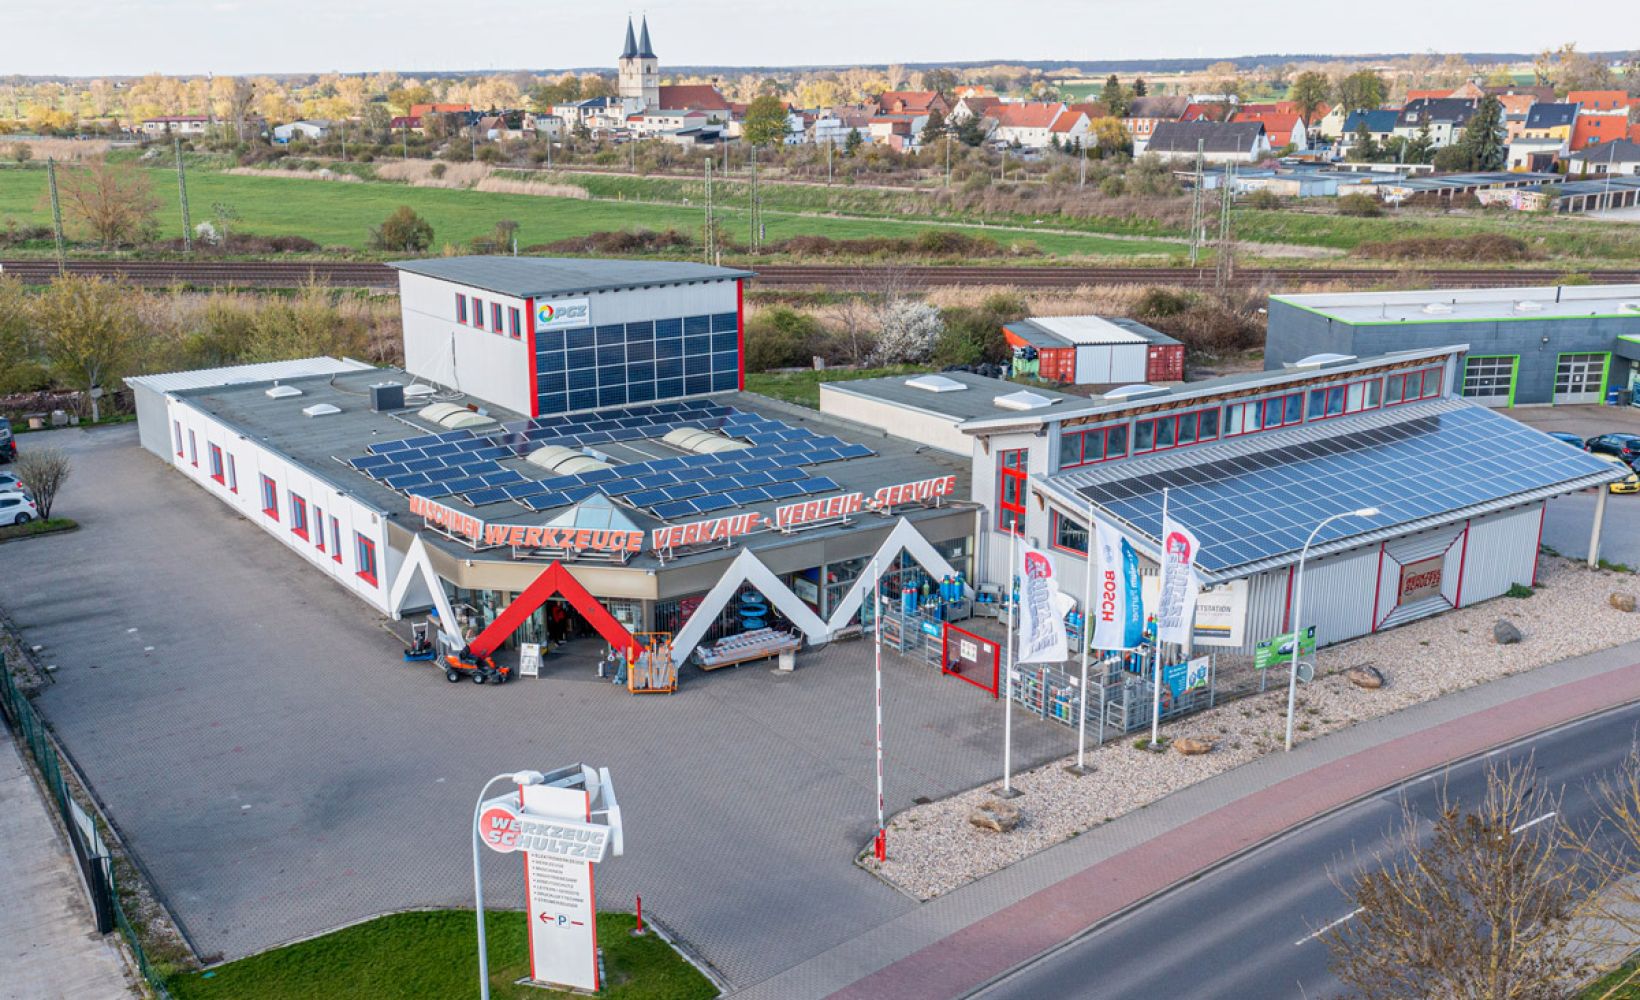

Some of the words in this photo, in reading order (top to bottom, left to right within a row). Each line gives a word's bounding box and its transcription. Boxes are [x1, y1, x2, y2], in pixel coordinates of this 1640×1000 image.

[555, 304, 587, 319] PGZ
[409, 494, 481, 540] MASCHINEN
[485, 523, 644, 552] WERKZEUGE
[653, 511, 761, 549] VERKAUF
[776, 492, 864, 528] VERLEIH
[875, 475, 957, 509] SERVICE
[488, 830, 601, 859] SCHULTZE
[491, 816, 605, 845] WERKZEUG
[558, 914, 567, 926] P
